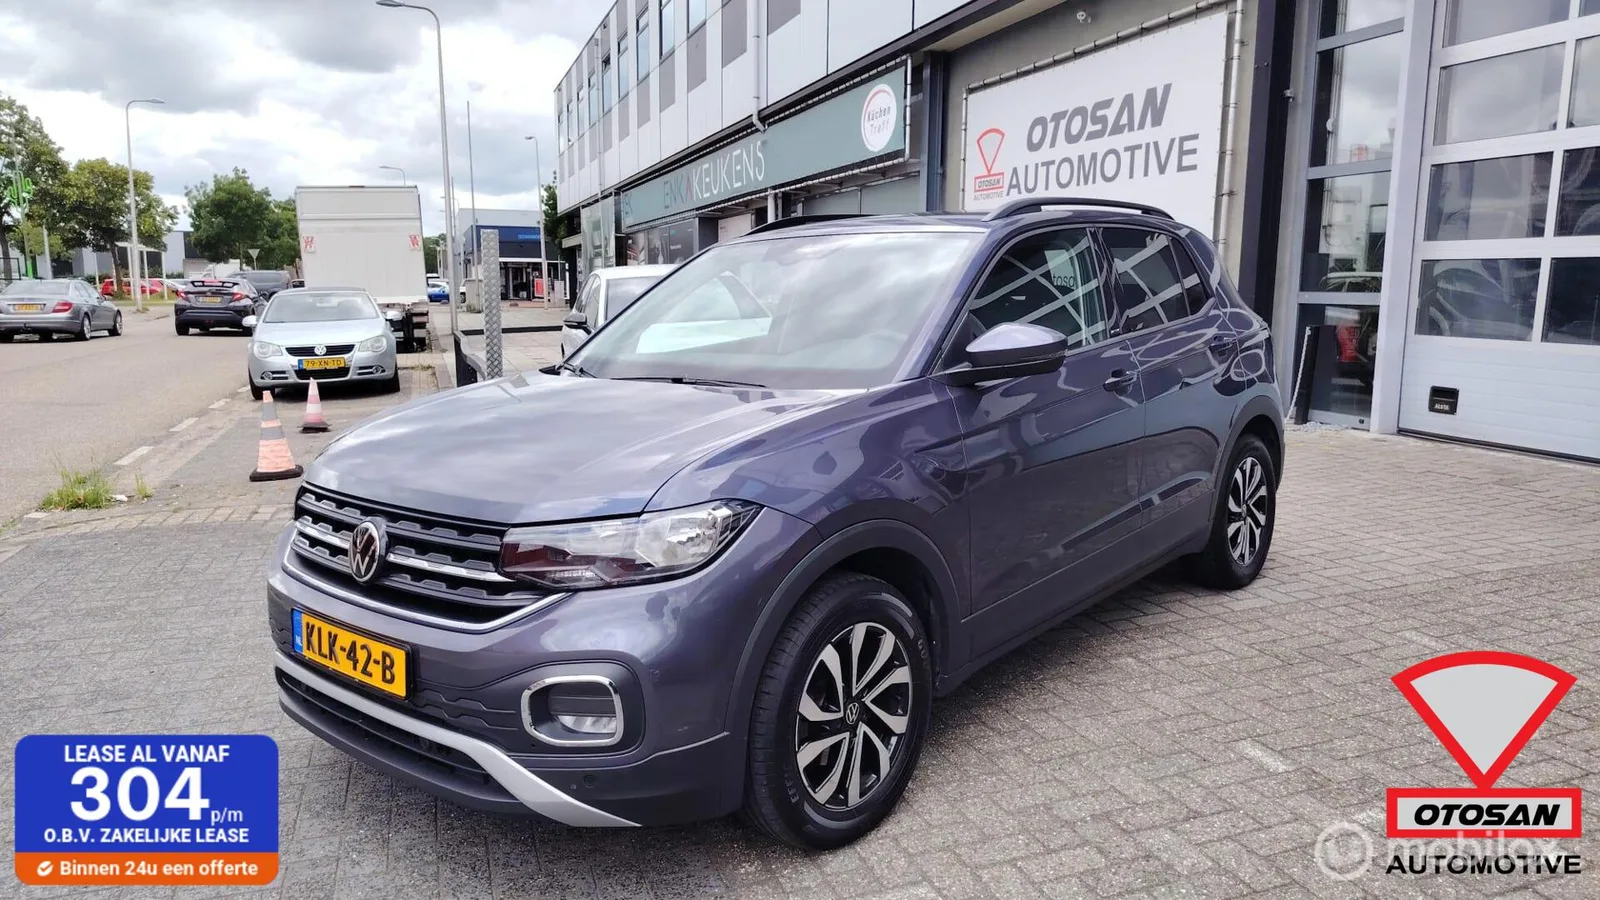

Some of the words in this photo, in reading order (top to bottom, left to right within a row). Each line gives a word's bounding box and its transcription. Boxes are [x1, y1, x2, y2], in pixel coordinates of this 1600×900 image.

[1027, 83, 1172, 153] OTOSAN
[692, 140, 765, 202] KEUKENS
[973, 190, 1004, 201] AUTOMOTIVE
[977, 178, 1001, 189] OTOSAN
[1006, 133, 1200, 196] AUTOMOTIVE
[305, 359, 342, 368] 79-XN-TD
[305, 621, 396, 685] KLK-42-B
